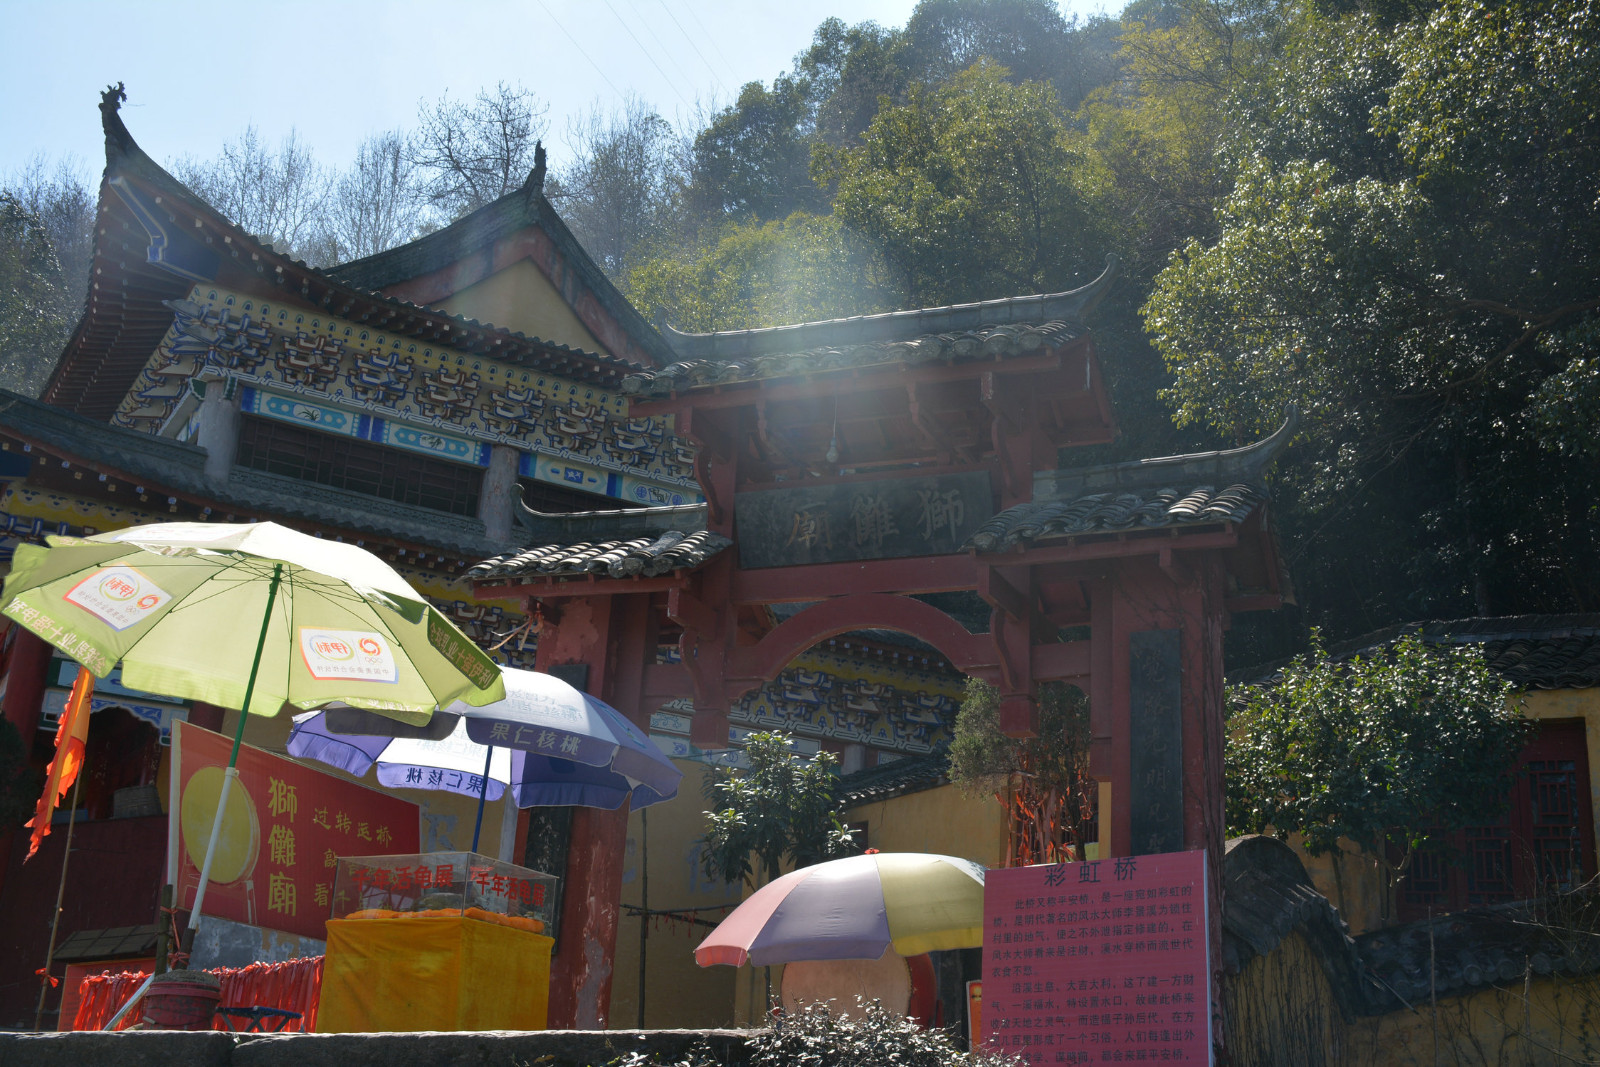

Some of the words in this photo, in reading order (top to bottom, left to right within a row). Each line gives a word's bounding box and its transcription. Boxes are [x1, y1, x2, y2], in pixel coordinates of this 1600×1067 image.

[430, 622, 495, 689] 全球乳业十强伊利
[489, 722, 583, 756] 果仁核桃
[313, 807, 393, 848] 过转运桥
[267, 776, 298, 917] 獅儺廟
[352, 864, 454, 891] 千年活龟展
[1044, 857, 1137, 887] 彩虹桥
[476, 873, 546, 908] 千年活龟展
